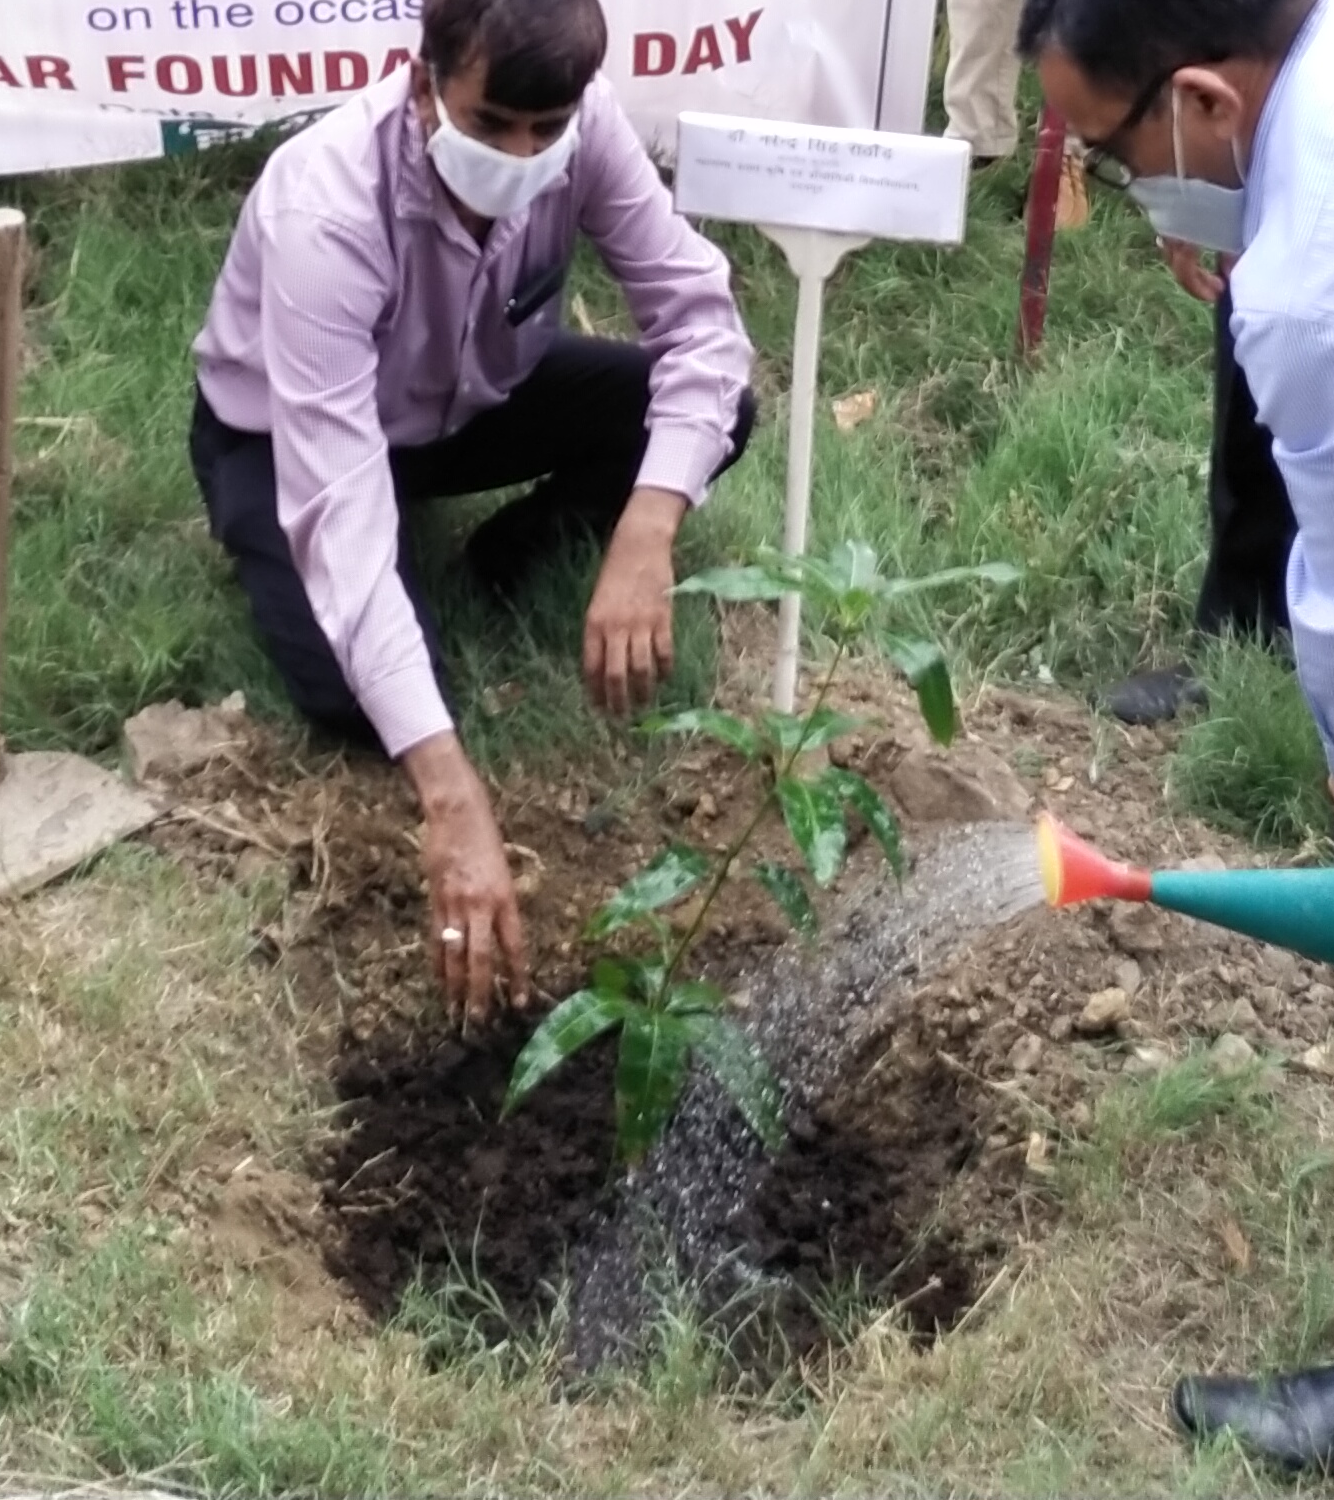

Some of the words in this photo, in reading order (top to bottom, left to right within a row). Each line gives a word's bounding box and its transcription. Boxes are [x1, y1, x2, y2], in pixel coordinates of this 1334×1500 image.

[87, 5, 153, 32] on
[106, 47, 412, 98] FOUNDA
[631, 8, 765, 77] DAY
